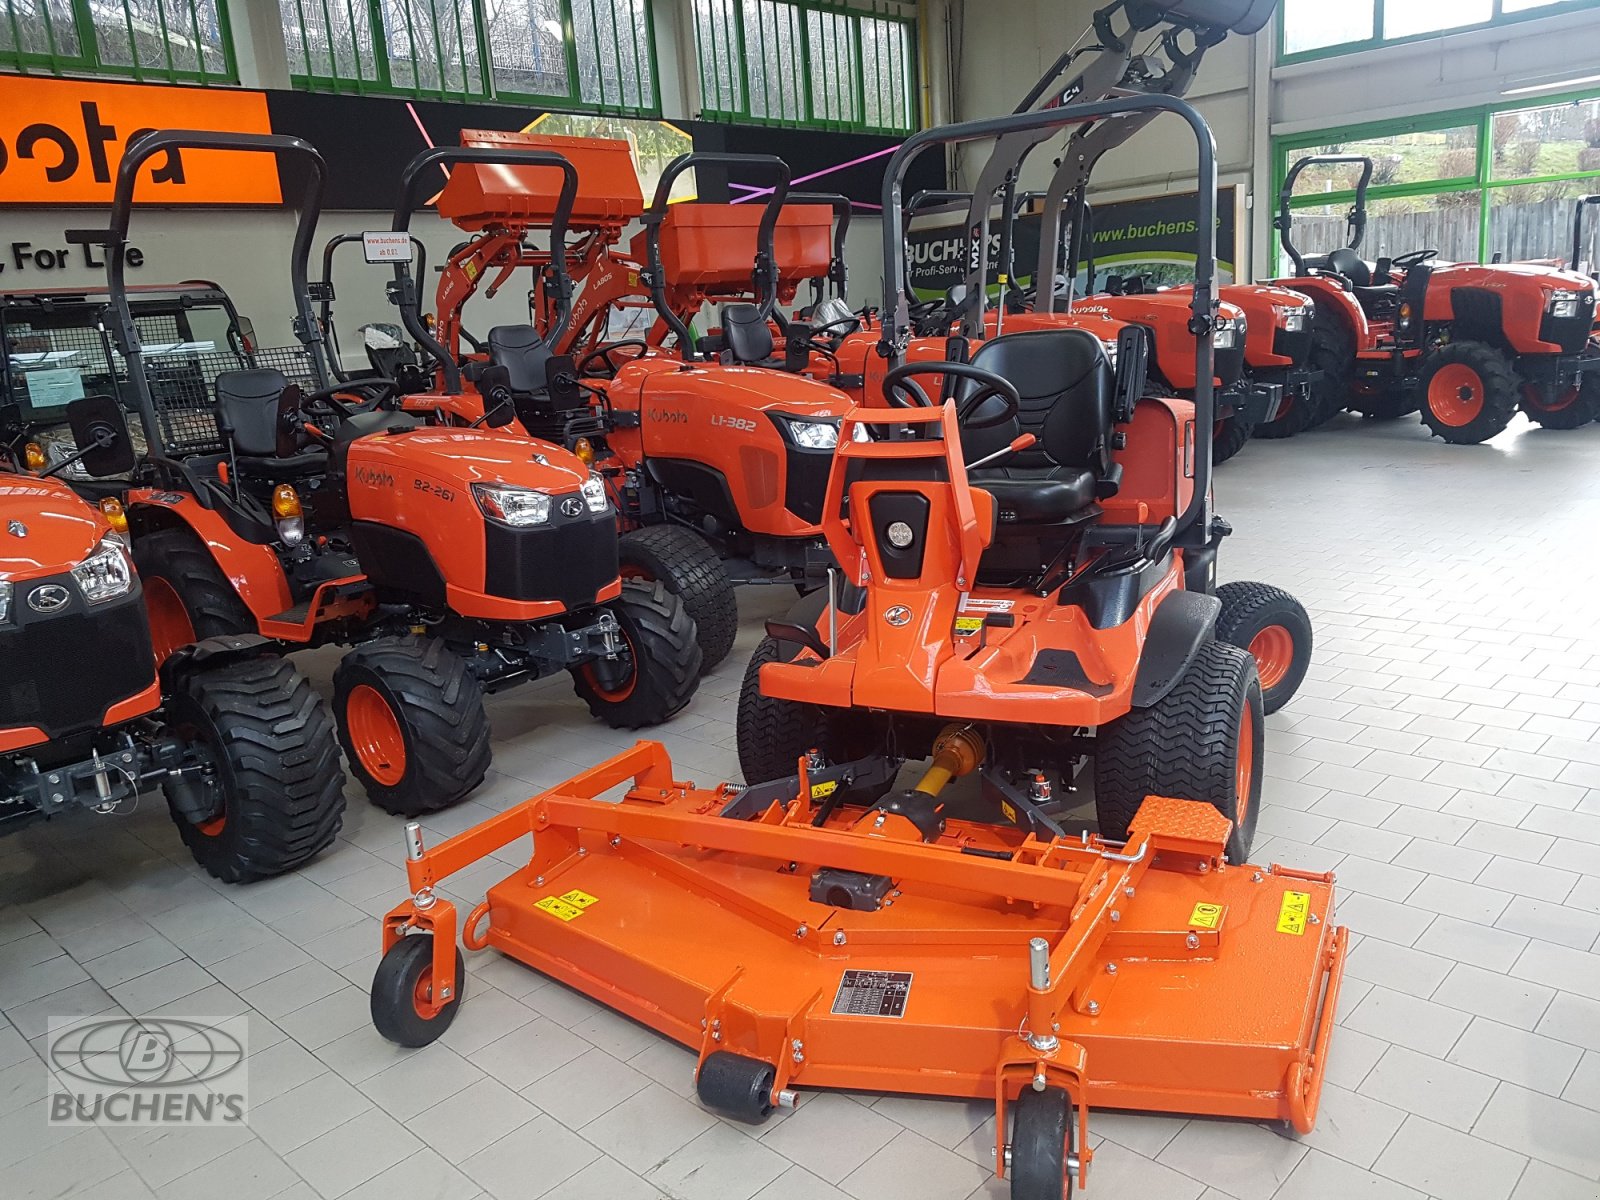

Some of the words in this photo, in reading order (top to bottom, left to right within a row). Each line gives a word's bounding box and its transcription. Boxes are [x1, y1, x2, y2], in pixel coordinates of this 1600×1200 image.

[12, 242, 69, 270] For
[83, 242, 144, 268] Le
[567, 298, 588, 332] Kubota
[647, 408, 689, 424] Kubota
[355, 465, 395, 488] Kubota
